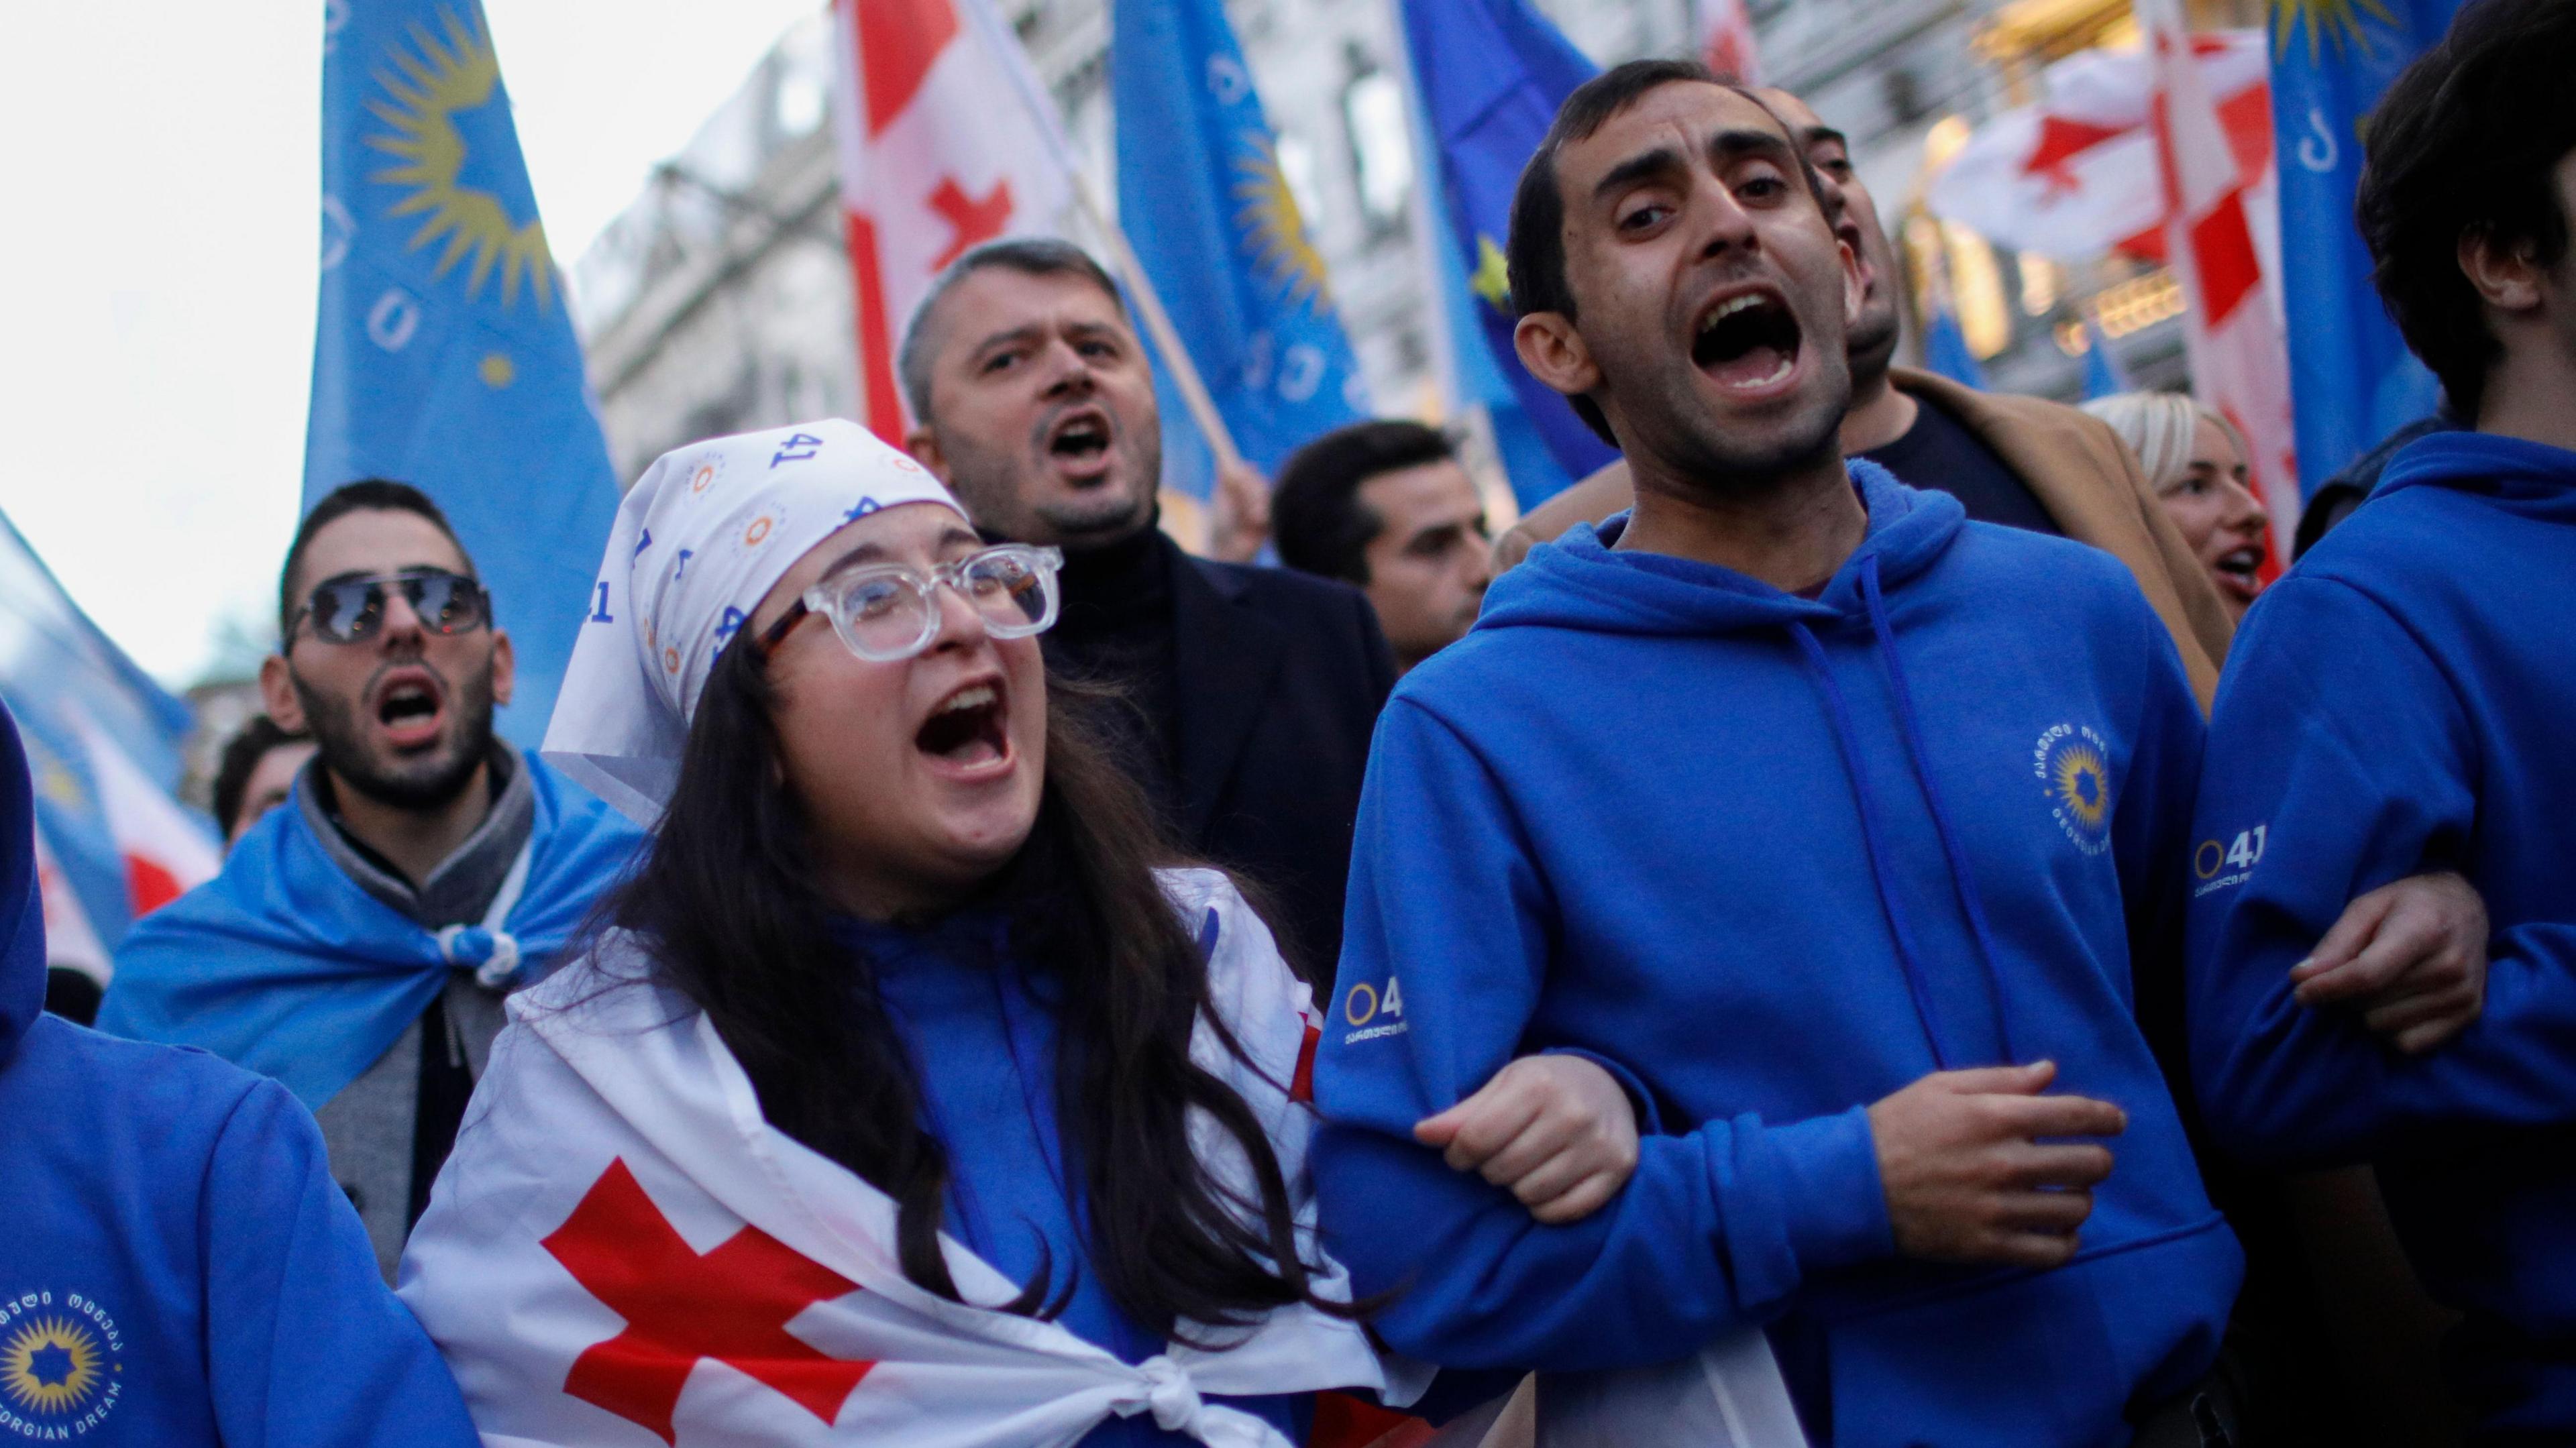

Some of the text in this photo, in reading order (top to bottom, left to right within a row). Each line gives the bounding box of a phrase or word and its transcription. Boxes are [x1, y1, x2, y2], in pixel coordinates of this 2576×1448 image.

[770, 434, 823, 469] 41
[582, 581, 613, 624] 1
[0, 1291, 123, 1351] თული ოცნება
[0, 1381, 122, 1440] ORGIAN DREAM
